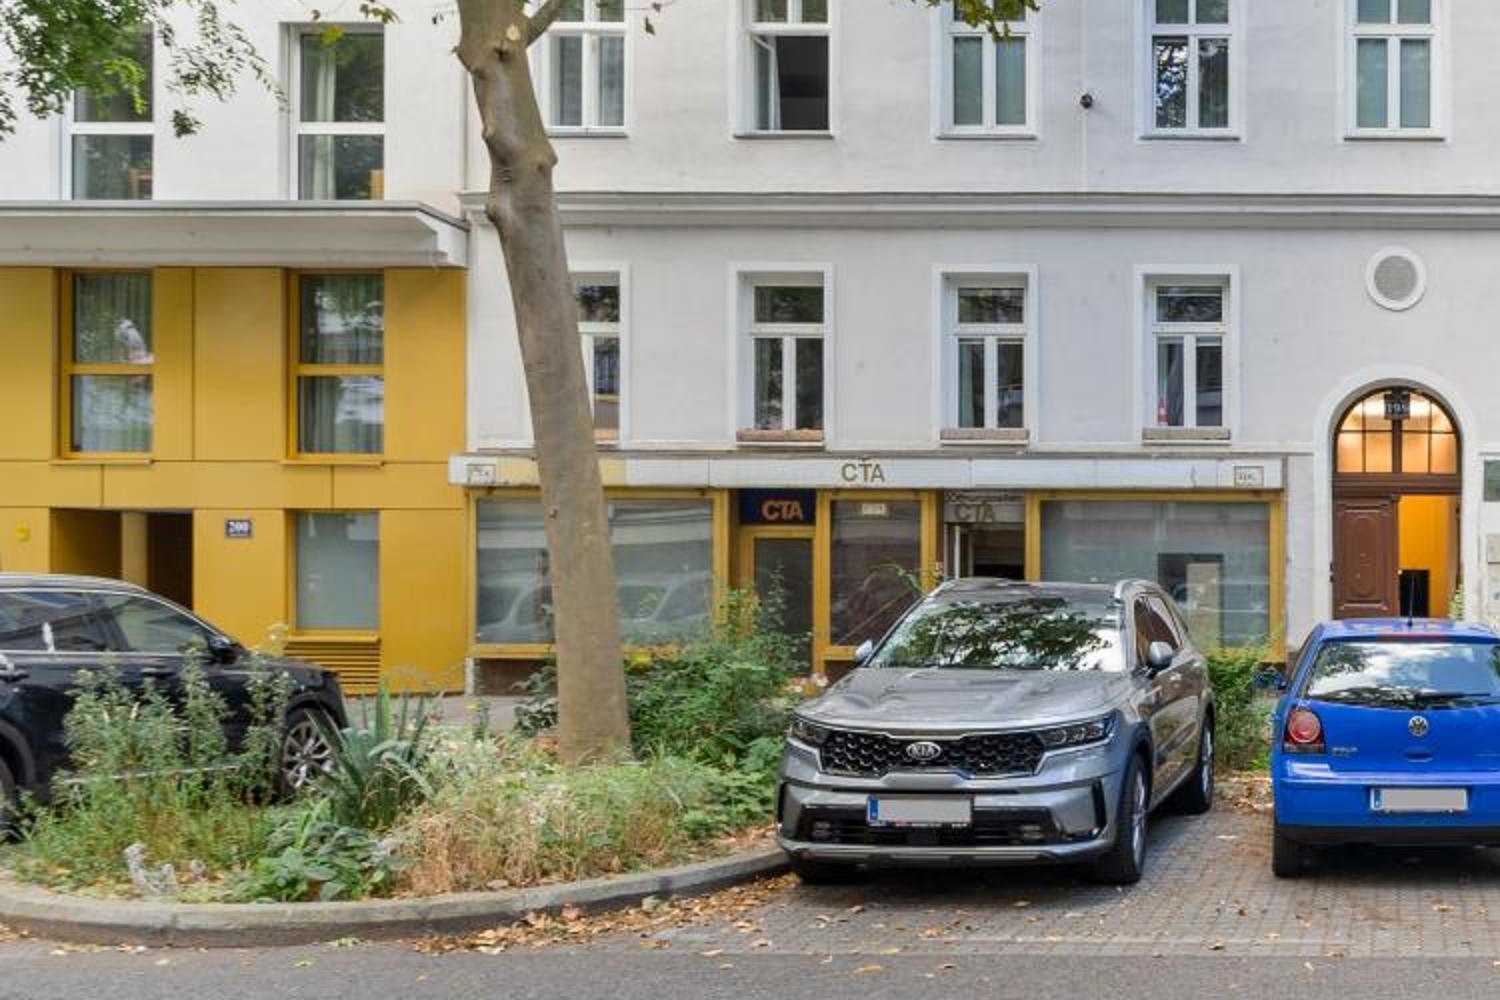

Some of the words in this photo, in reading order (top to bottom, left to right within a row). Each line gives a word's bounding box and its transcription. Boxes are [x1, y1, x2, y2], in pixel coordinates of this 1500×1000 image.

[841, 463, 885, 483] CTA
[762, 501, 804, 520] CTA
[954, 502, 995, 522] CTA
[908, 743, 938, 758] KIA
